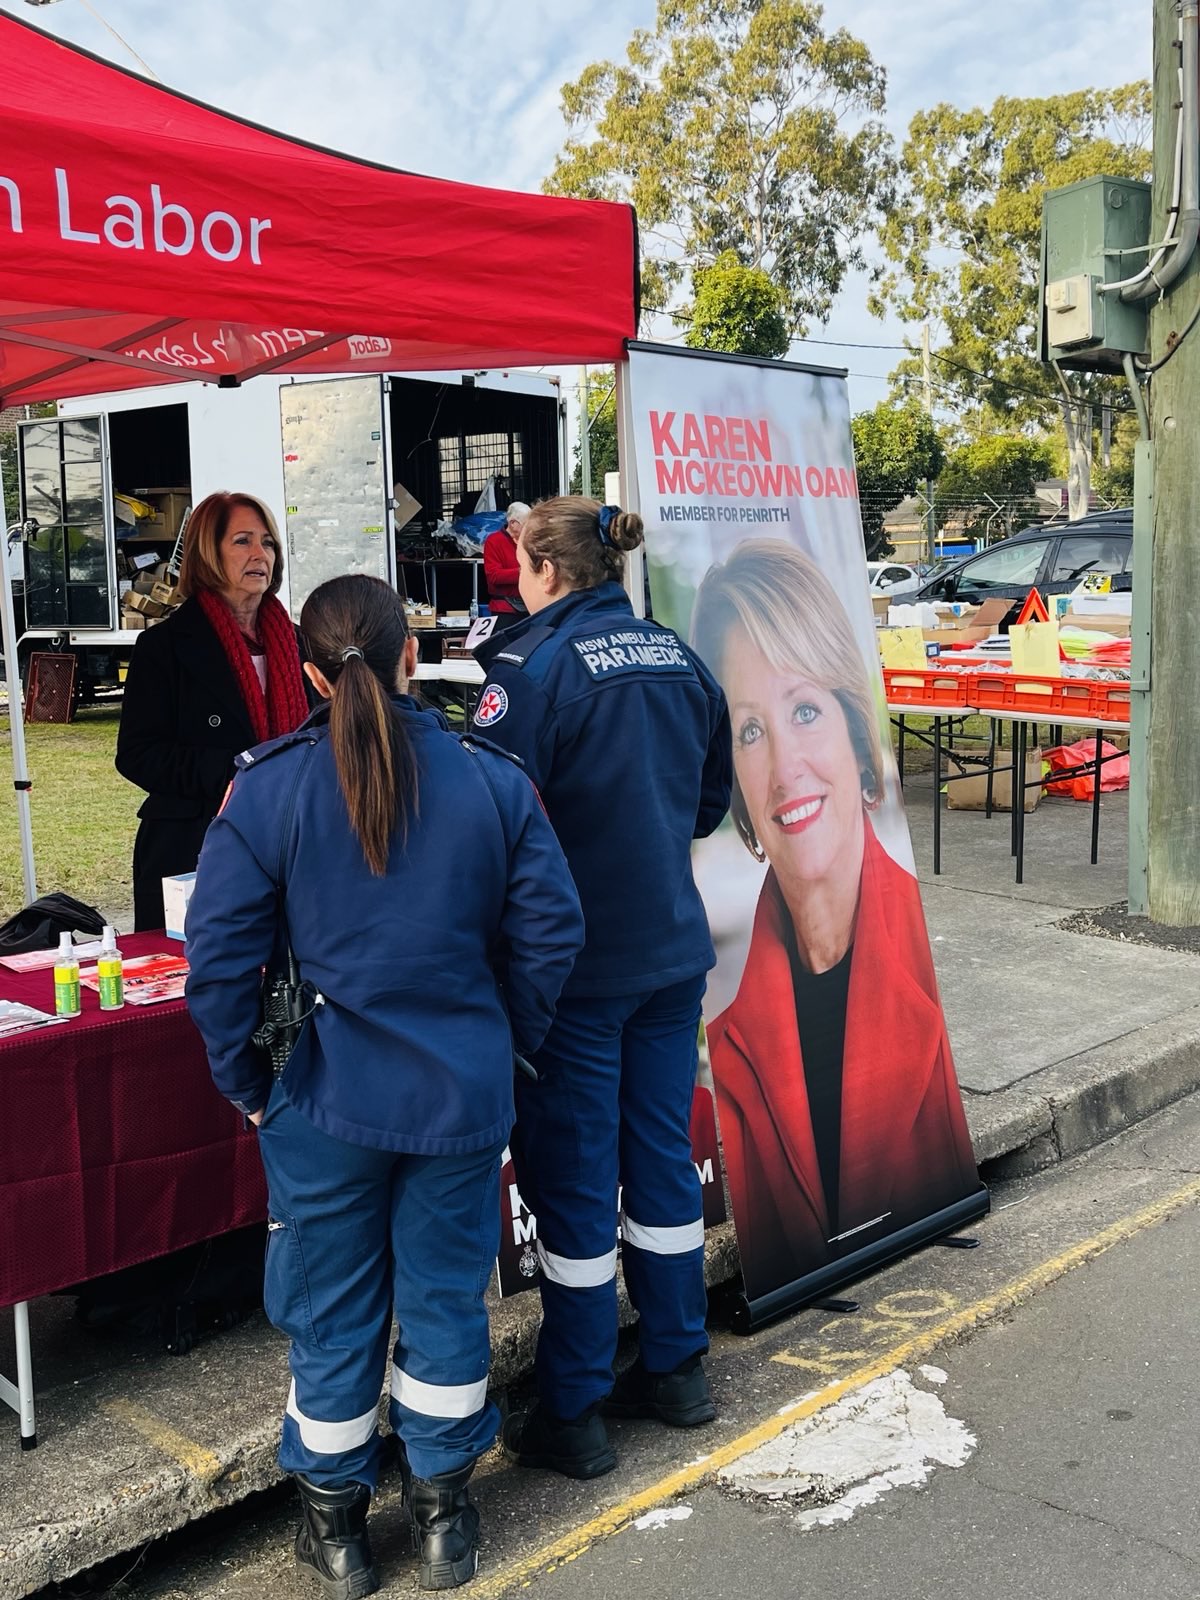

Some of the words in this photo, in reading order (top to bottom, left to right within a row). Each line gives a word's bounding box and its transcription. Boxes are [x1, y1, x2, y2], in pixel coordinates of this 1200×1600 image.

[54, 167, 272, 265] Labor
[649, 410, 773, 462] KAREN
[655, 459, 805, 498] MCKEOWN
[805, 465, 858, 499] OAM
[659, 505, 716, 522] MEMBER
[717, 506, 739, 522] FOR
[739, 507, 791, 523] PENRITH
[476, 618, 492, 636] 2
[574, 636, 609, 654] NSW
[609, 632, 679, 647] AMBULANCE
[582, 645, 688, 675] PARAMEDIC
